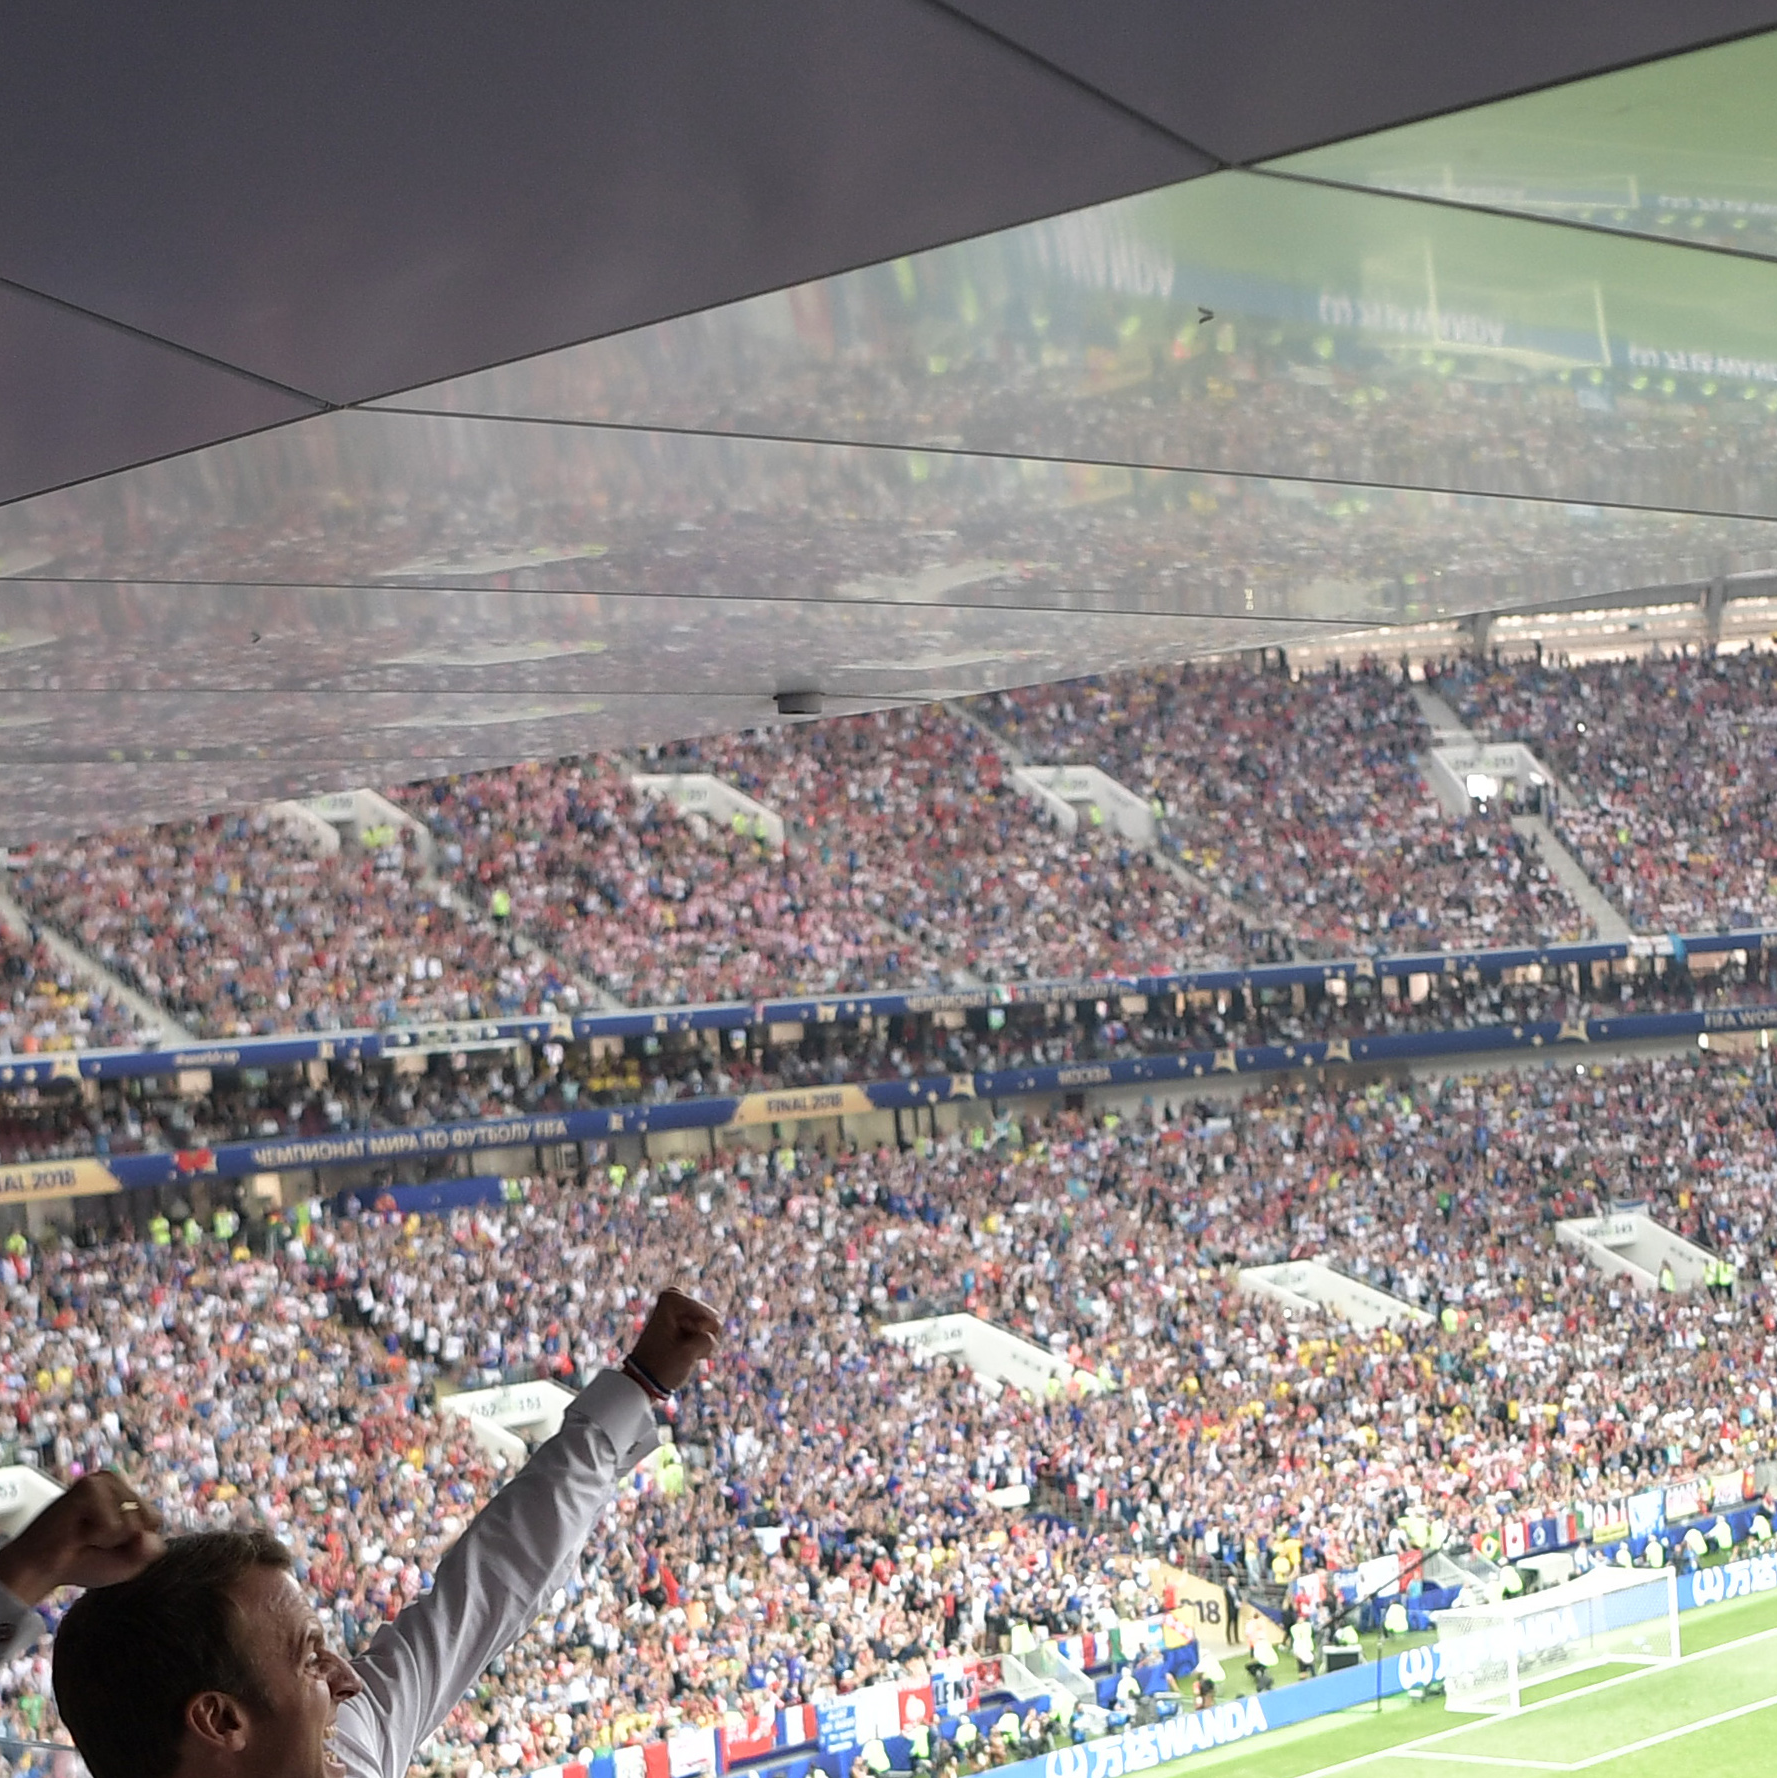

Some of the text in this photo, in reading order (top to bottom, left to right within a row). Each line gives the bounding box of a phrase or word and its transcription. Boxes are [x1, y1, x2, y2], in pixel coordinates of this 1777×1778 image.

[253, 1141, 366, 1166] ЧЕМПИОНАТ
[370, 1135, 420, 1157] МИРА
[422, 1129, 450, 1149] ПО
[934, 1675, 974, 1707] LENS
